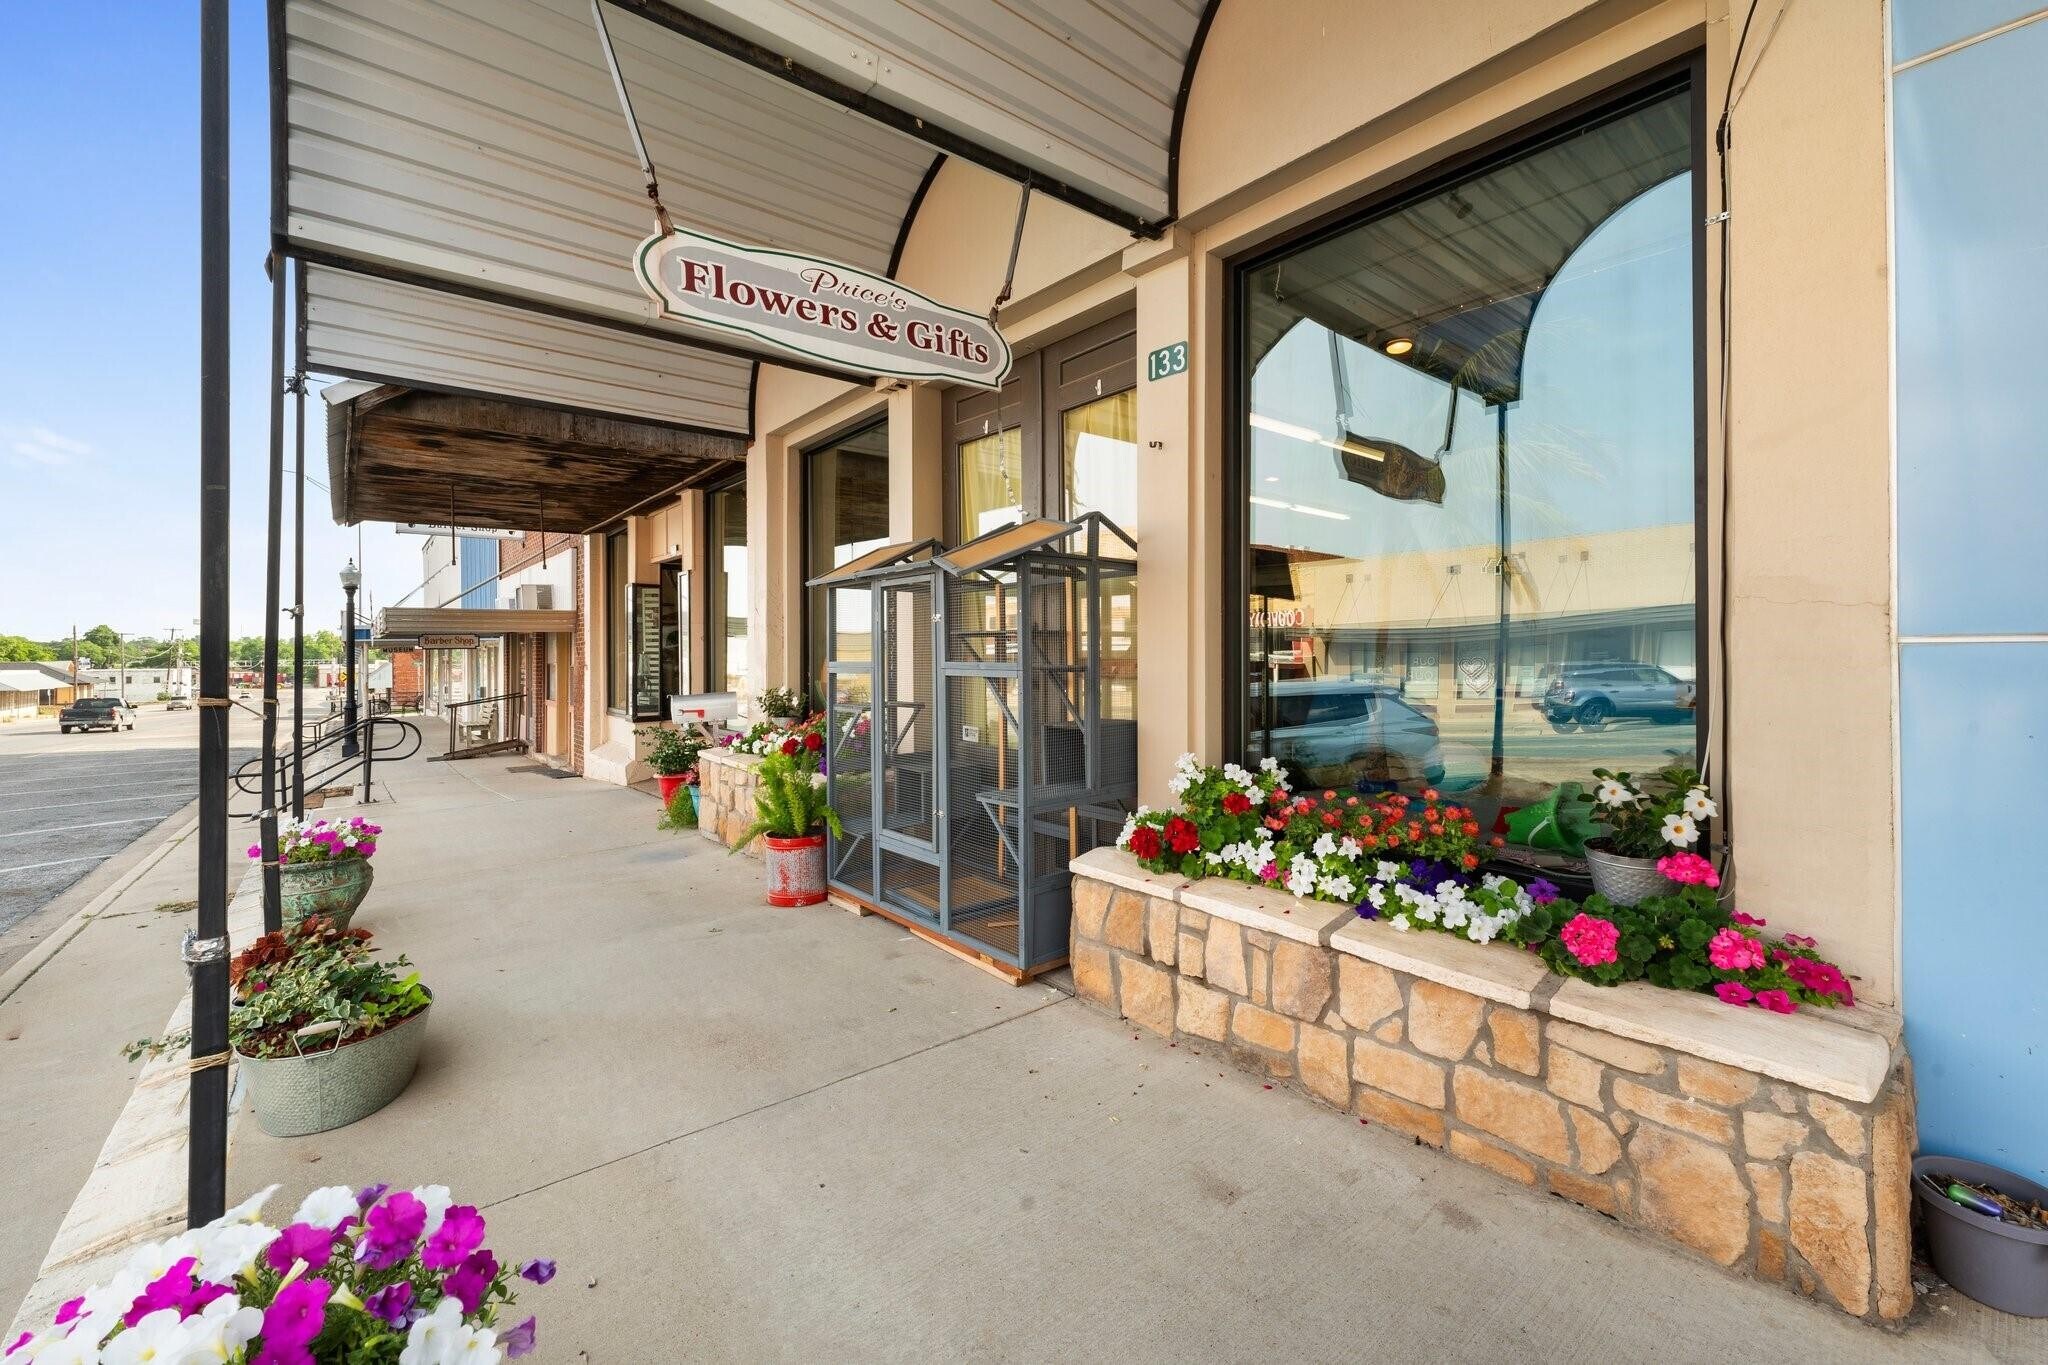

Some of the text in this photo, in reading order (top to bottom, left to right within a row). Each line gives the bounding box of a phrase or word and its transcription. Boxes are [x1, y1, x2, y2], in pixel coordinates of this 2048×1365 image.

[800, 267, 907, 310] Price's
[680, 258, 988, 364] Flowers & Gifts
[1150, 345, 1186, 379] 133
[424, 635, 474, 646] Barber Shop
